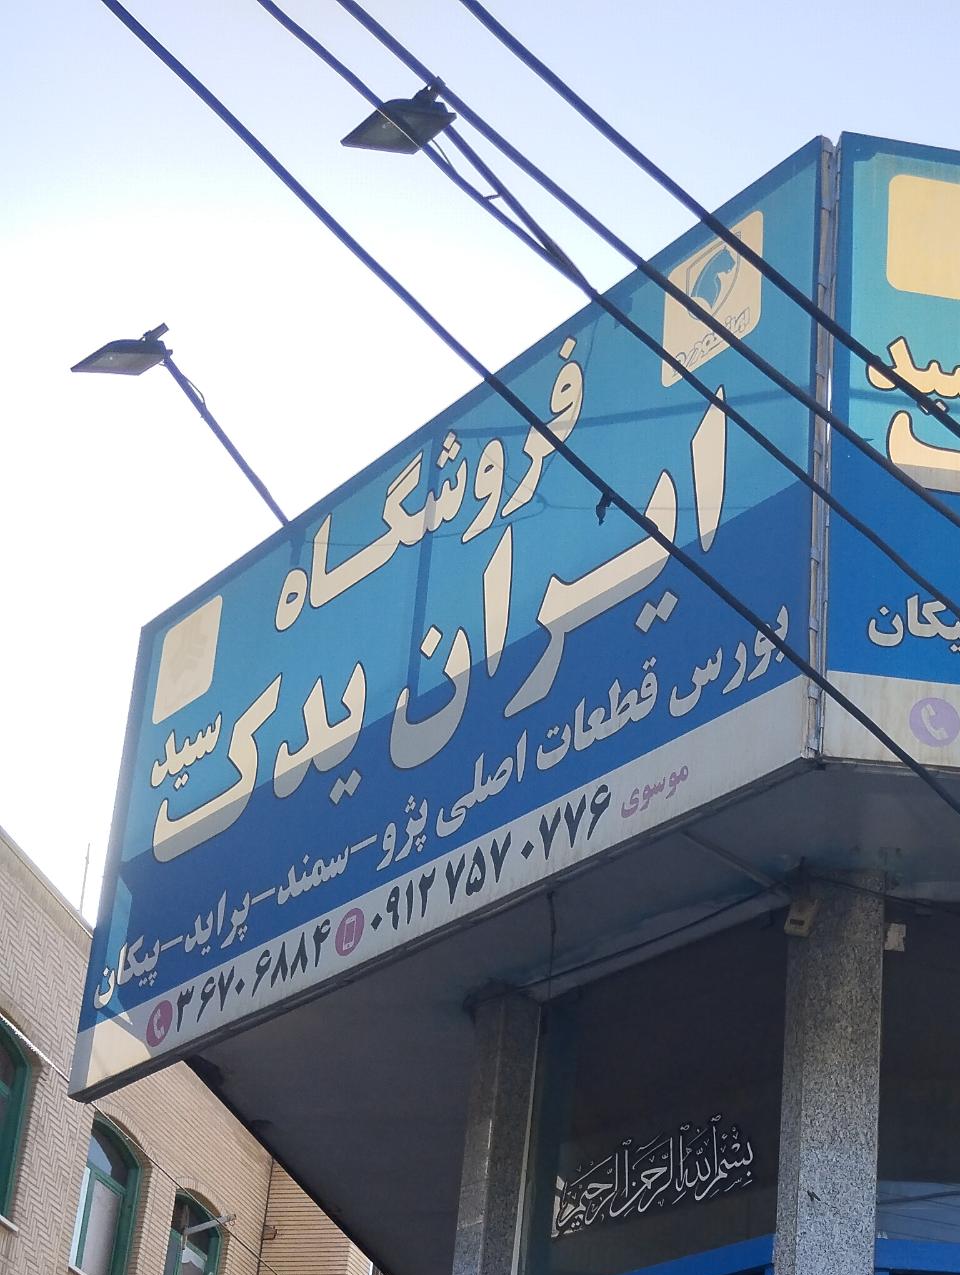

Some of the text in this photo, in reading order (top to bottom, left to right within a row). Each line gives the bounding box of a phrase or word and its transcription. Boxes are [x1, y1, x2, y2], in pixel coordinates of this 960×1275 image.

[275, 336, 585, 632] فروشگاه
[152, 384, 728, 863] ایران یدک
[669, 604, 790, 718] بورس
[151, 711, 222, 792] سید
[536, 656, 659, 770] قطعات
[435, 729, 527, 838] اصلی
[620, 764, 690, 819] موسوی
